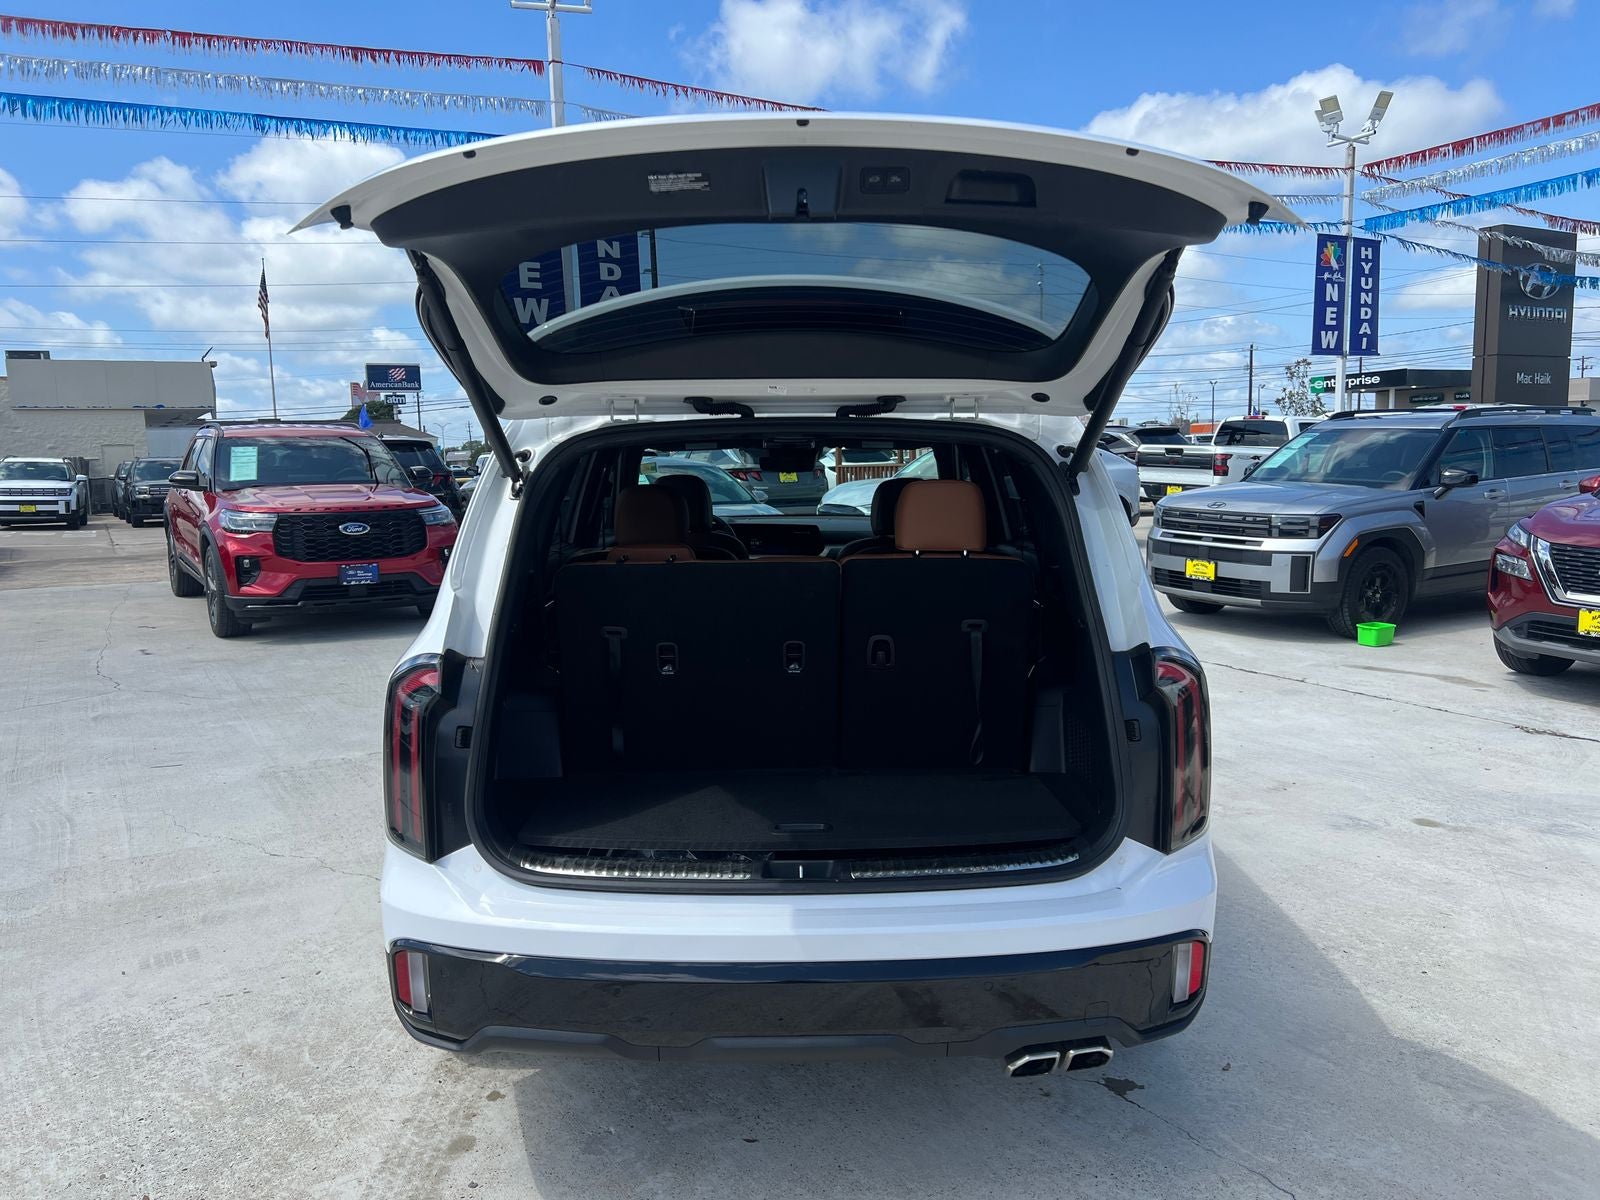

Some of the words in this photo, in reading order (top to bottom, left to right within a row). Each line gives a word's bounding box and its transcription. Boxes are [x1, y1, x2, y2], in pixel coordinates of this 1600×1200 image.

[1358, 247, 1373, 349] HYUNDAI
[1320, 283, 1339, 349] NEW
[1509, 305, 1567, 323] HYUNDAI
[1312, 375, 1380, 389] entprise
[1516, 372, 1533, 384] Mac
[1534, 373, 1551, 384] Haik
[387, 396, 406, 404] atm
